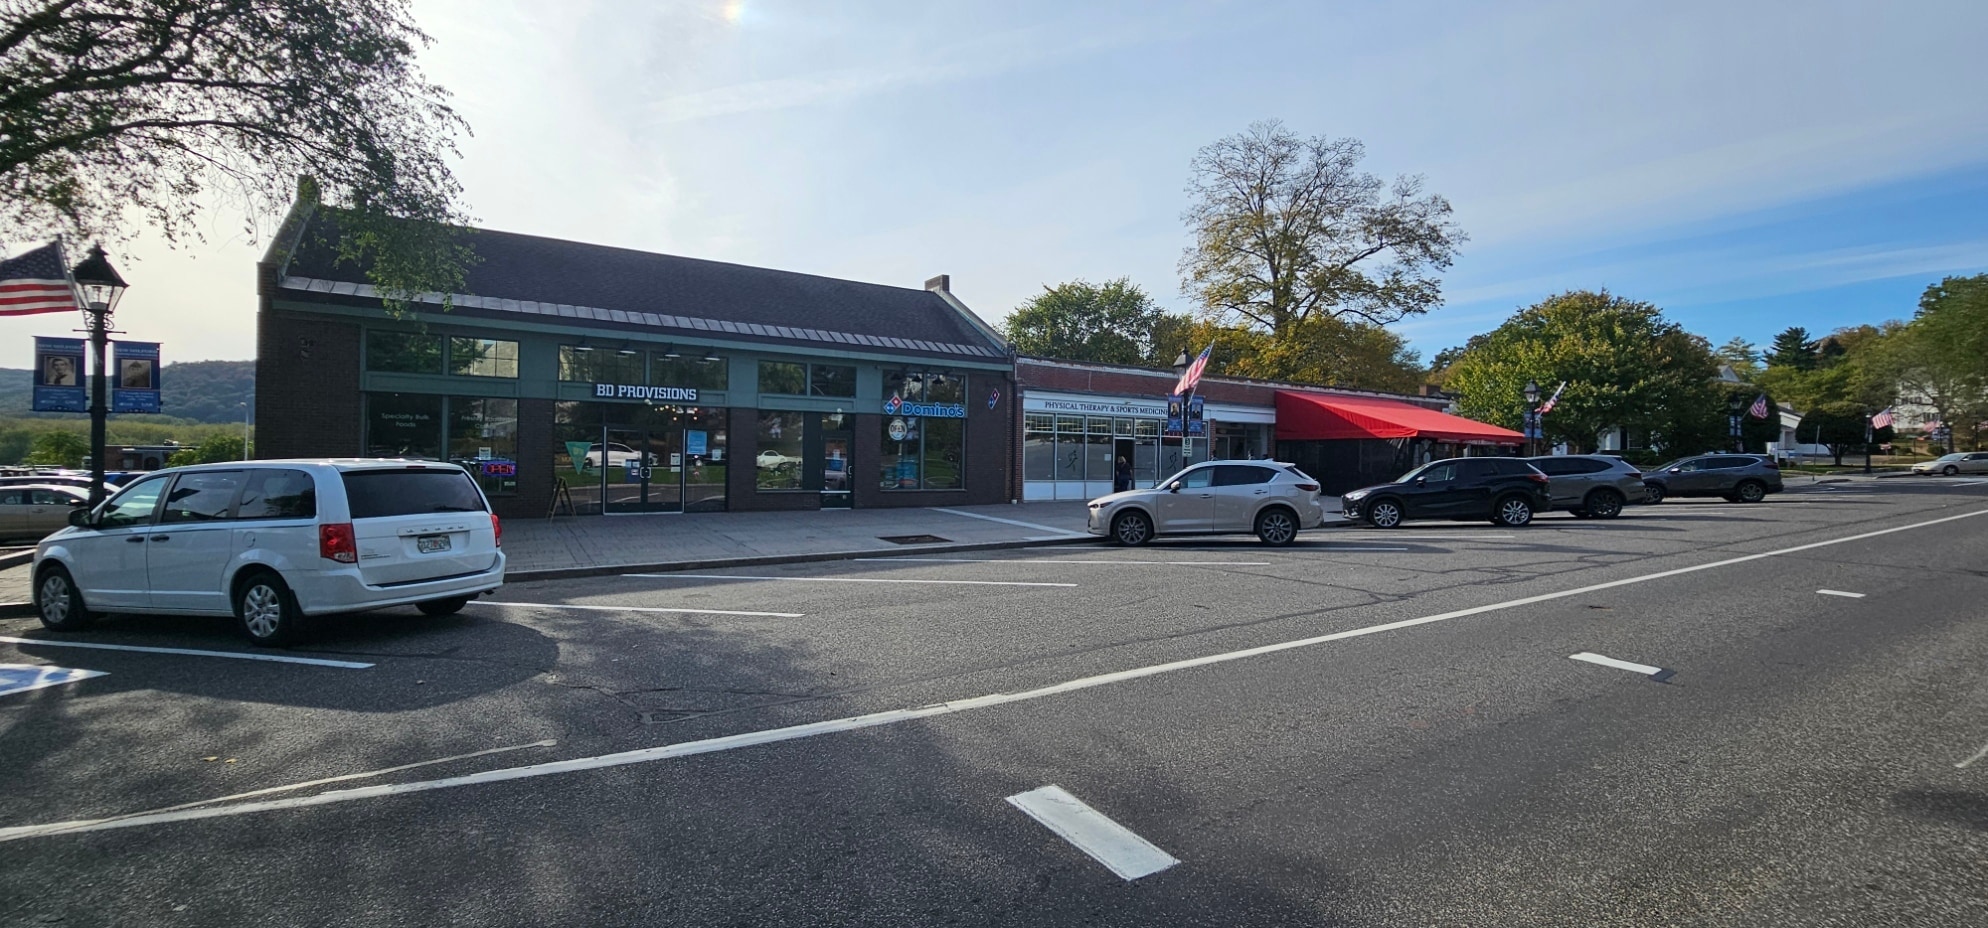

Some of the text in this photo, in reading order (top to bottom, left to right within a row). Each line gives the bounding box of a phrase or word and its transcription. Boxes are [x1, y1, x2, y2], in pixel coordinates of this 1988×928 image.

[596, 383, 697, 401] BD PROVISIONS
[902, 401, 965, 417] Domino's
[1045, 401, 1078, 410] PHYSICAL
[1080, 403, 1109, 412] THERAPY
[1116, 406, 1139, 414] SPORTS
[487, 464, 516, 475] OPEN
